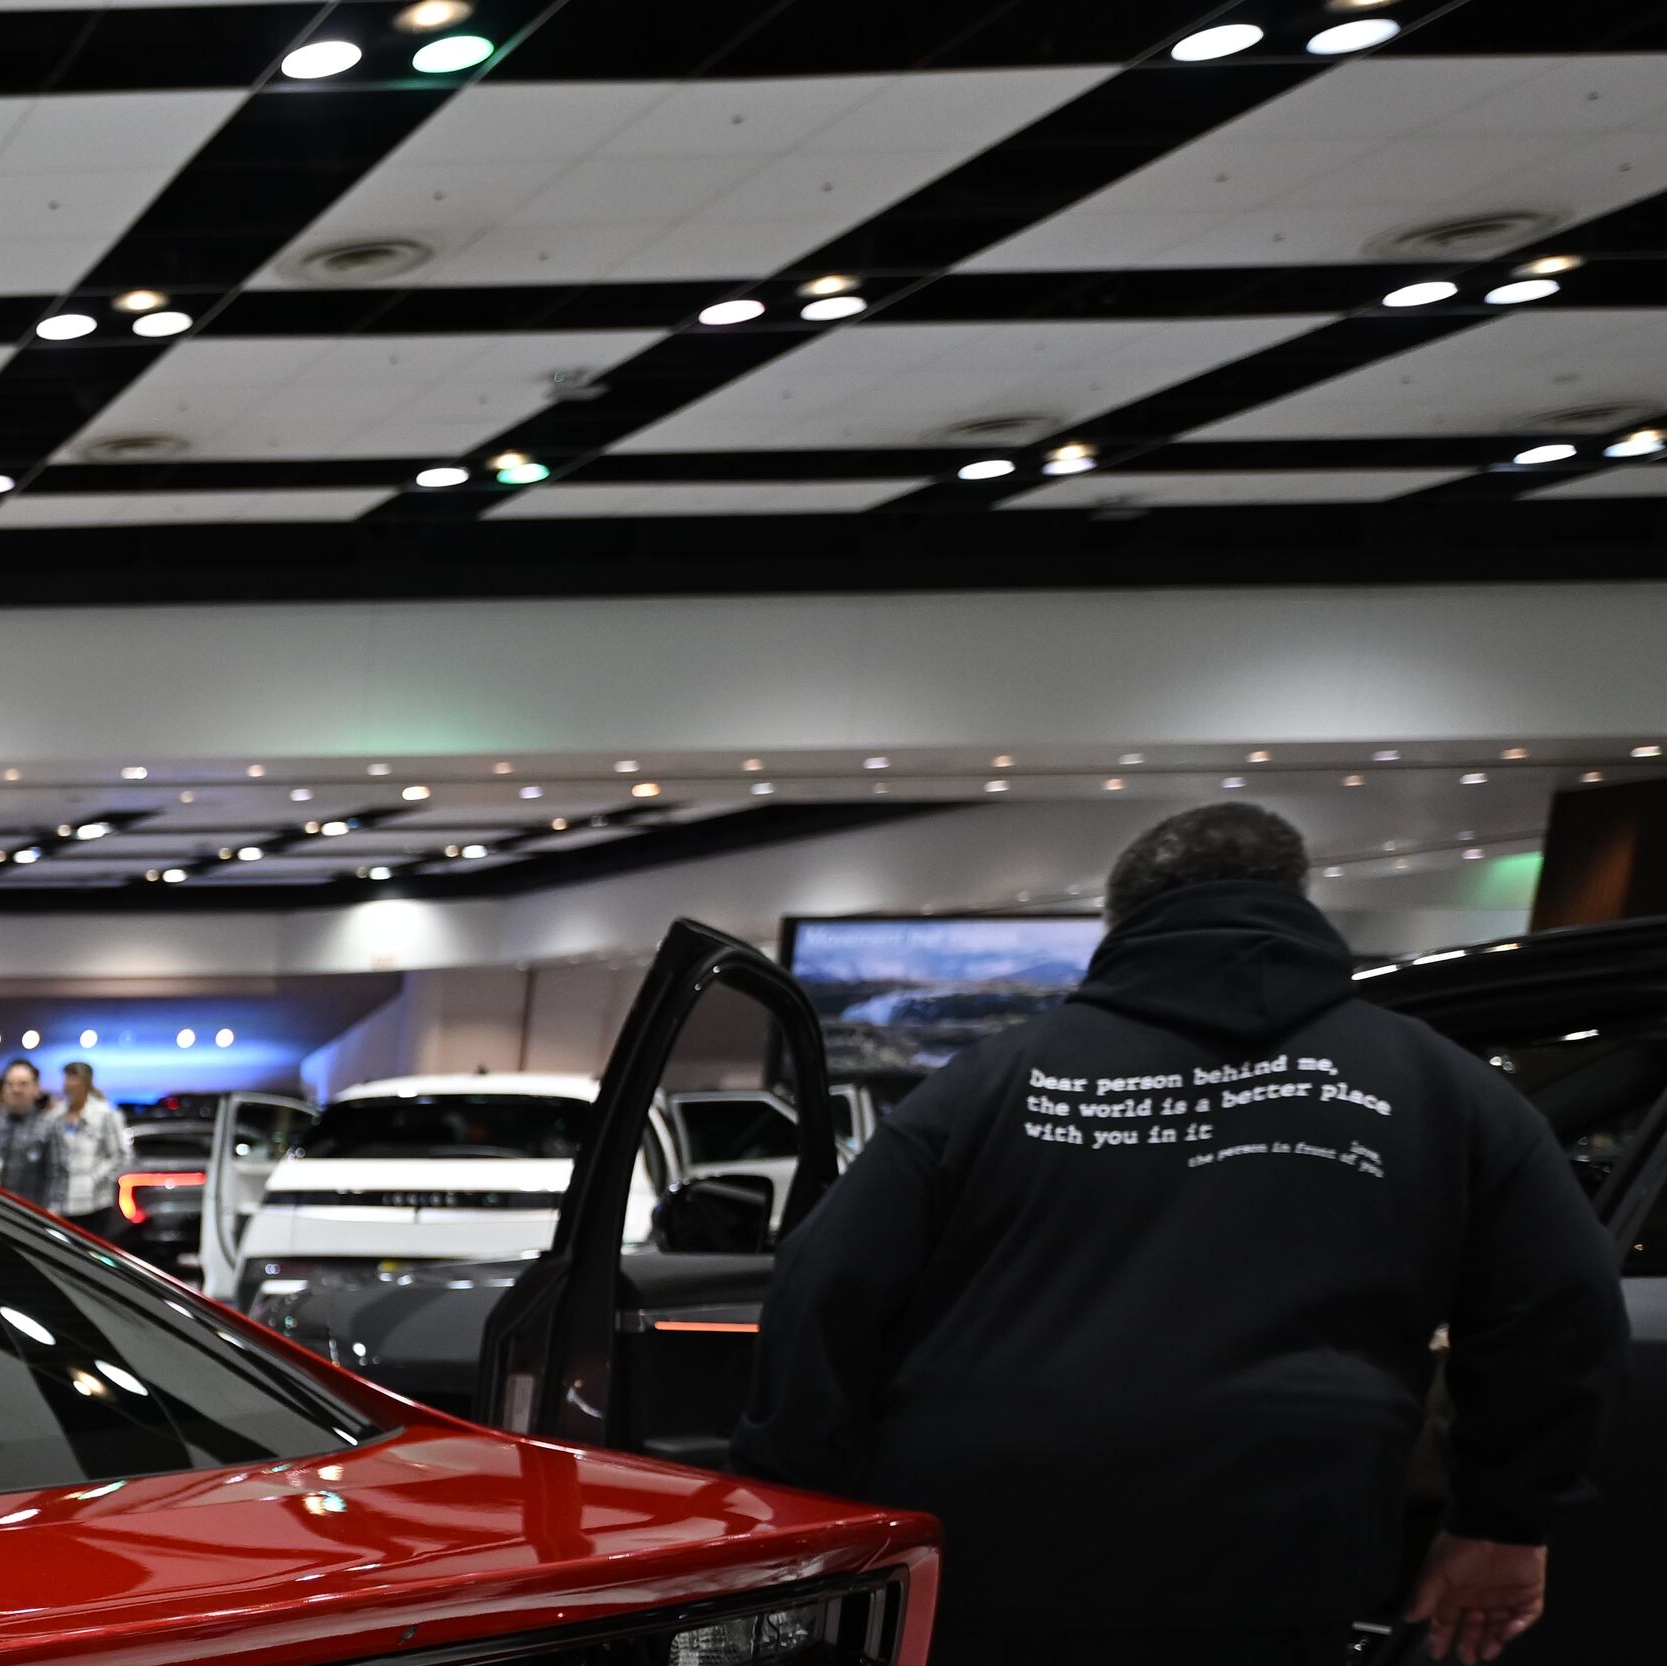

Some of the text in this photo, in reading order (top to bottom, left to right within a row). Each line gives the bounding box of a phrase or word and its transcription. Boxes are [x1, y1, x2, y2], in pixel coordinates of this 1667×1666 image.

[1029, 1067, 1088, 1092] Dear
[1096, 1073, 1184, 1096] person
[1192, 1054, 1289, 1086] behind
[1026, 1081, 1392, 1118] the world is a better place
[1024, 1121, 1214, 1149] with you in it
[1216, 1143, 1269, 1162] person
[1271, 1140, 1292, 1153] in
[1293, 1141, 1338, 1160] front
[1338, 1151, 1359, 1166] of
